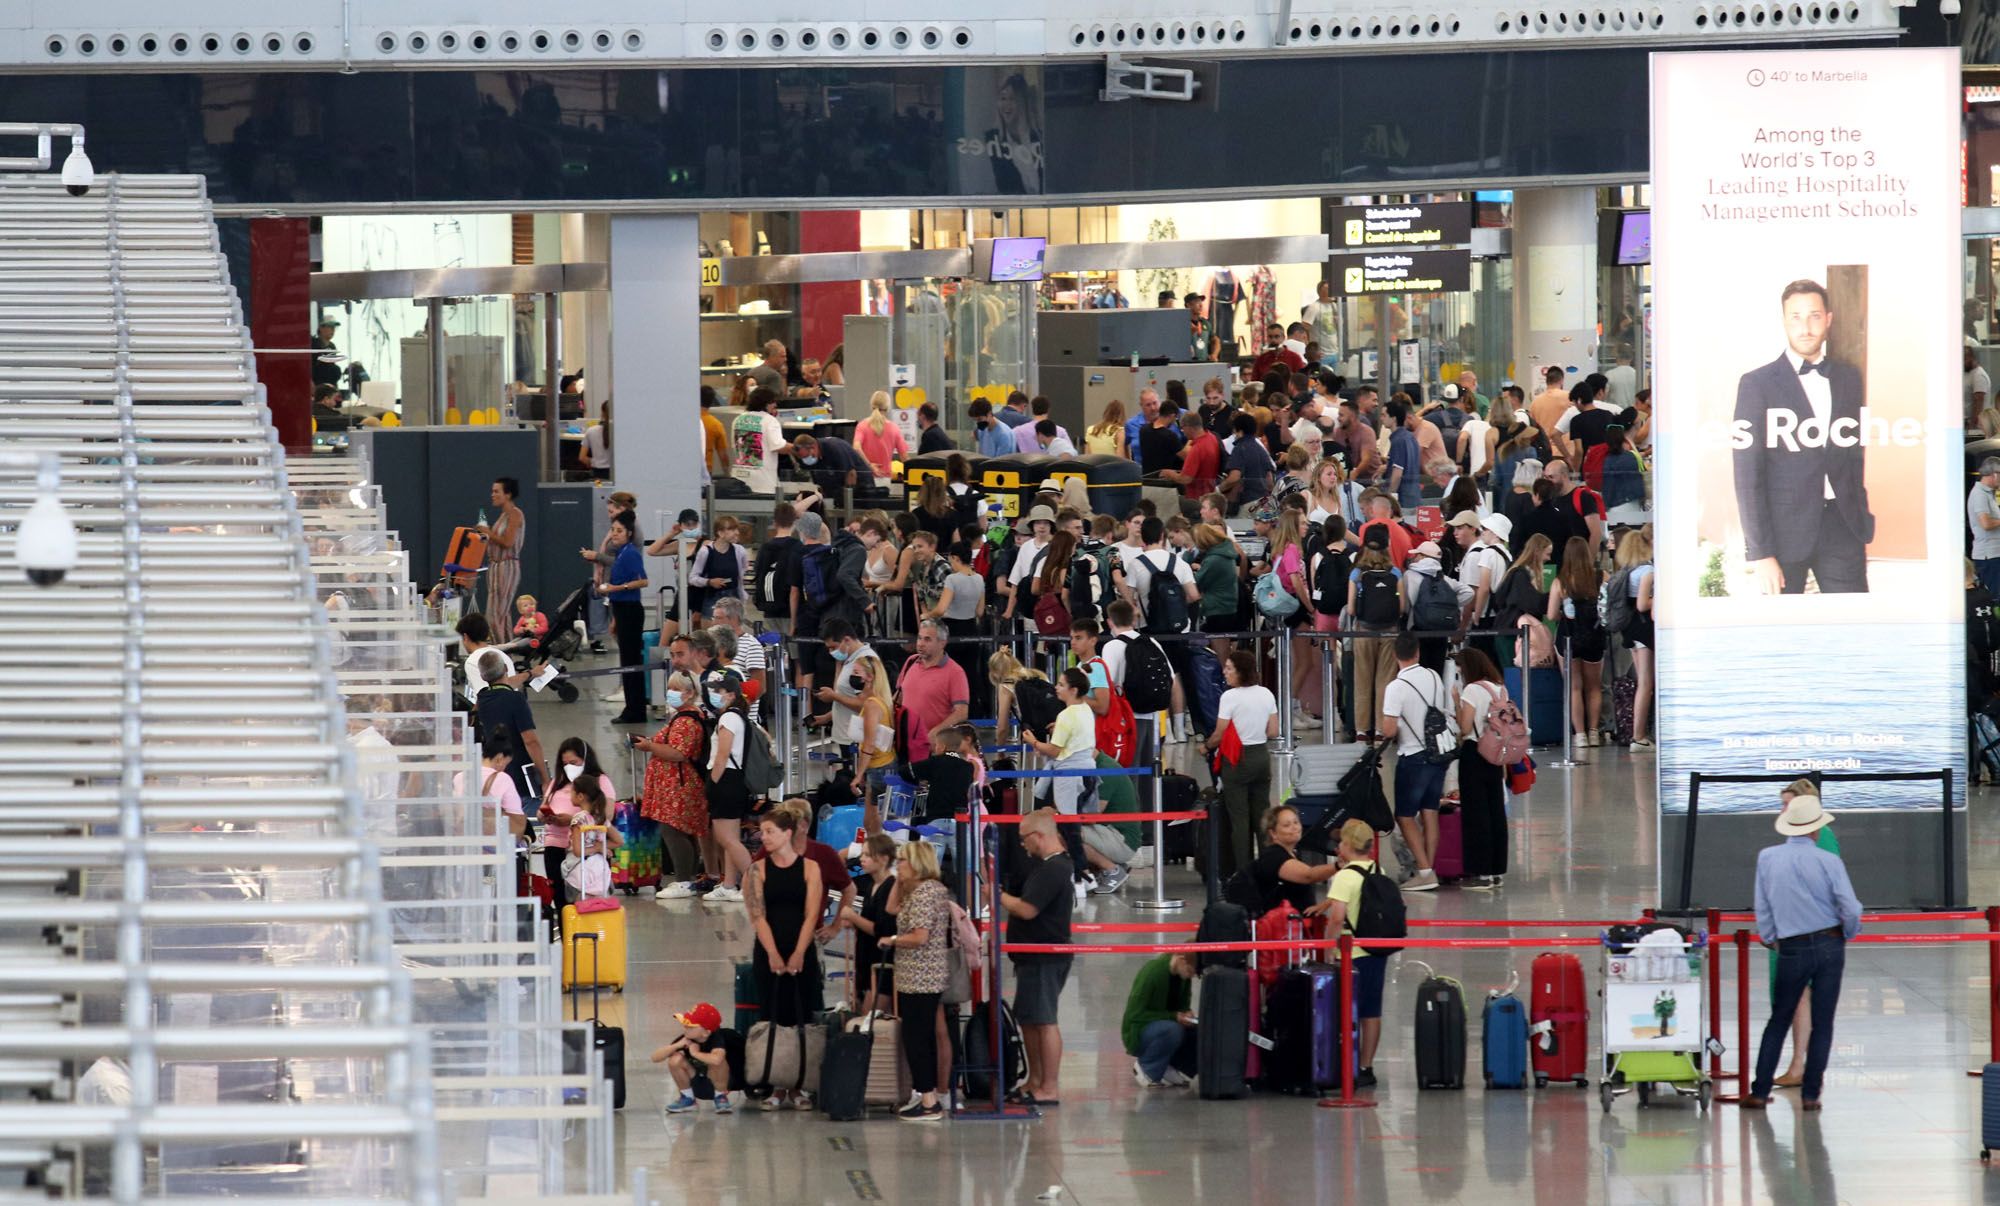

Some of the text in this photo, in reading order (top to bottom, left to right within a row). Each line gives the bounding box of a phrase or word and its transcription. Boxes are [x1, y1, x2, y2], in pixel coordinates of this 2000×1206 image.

[1795, 70, 1808, 82] to
[1812, 69, 1868, 82] Marbella
[1754, 125, 1862, 147] Among the
[1741, 150, 1876, 170] World's Top 3
[1708, 173, 1910, 197] Leading Hospitality
[1701, 199, 1918, 223] Management Schools
[703, 264, 720, 283] 10
[1723, 737, 1741, 748] Be
[1805, 734, 1824, 746] Be
[1826, 734, 1851, 746] Les
[1766, 757, 1861, 771] lesroches.edu
